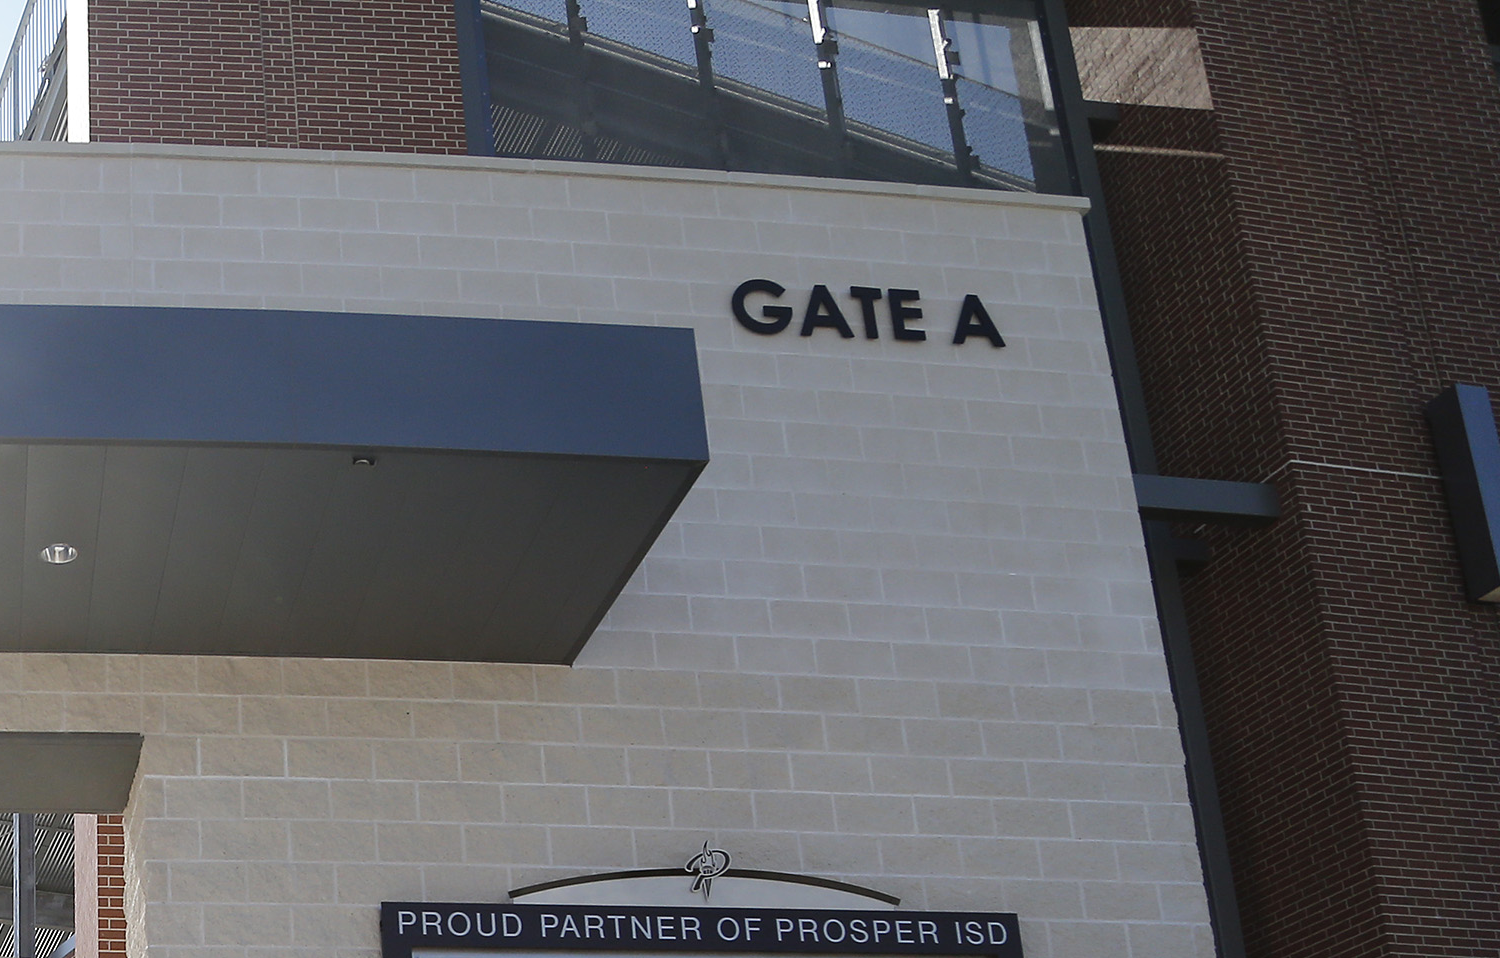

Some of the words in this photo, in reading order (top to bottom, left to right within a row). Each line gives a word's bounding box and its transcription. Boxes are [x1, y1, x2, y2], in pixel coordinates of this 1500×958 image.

[731, 278, 927, 341] GATE
[952, 294, 1007, 348] A
[397, 910, 524, 938] PROUD
[540, 913, 703, 941] PARTNER
[716, 916, 762, 942] OF
[775, 917, 940, 945] PROSPER
[954, 920, 1008, 946] ISD
